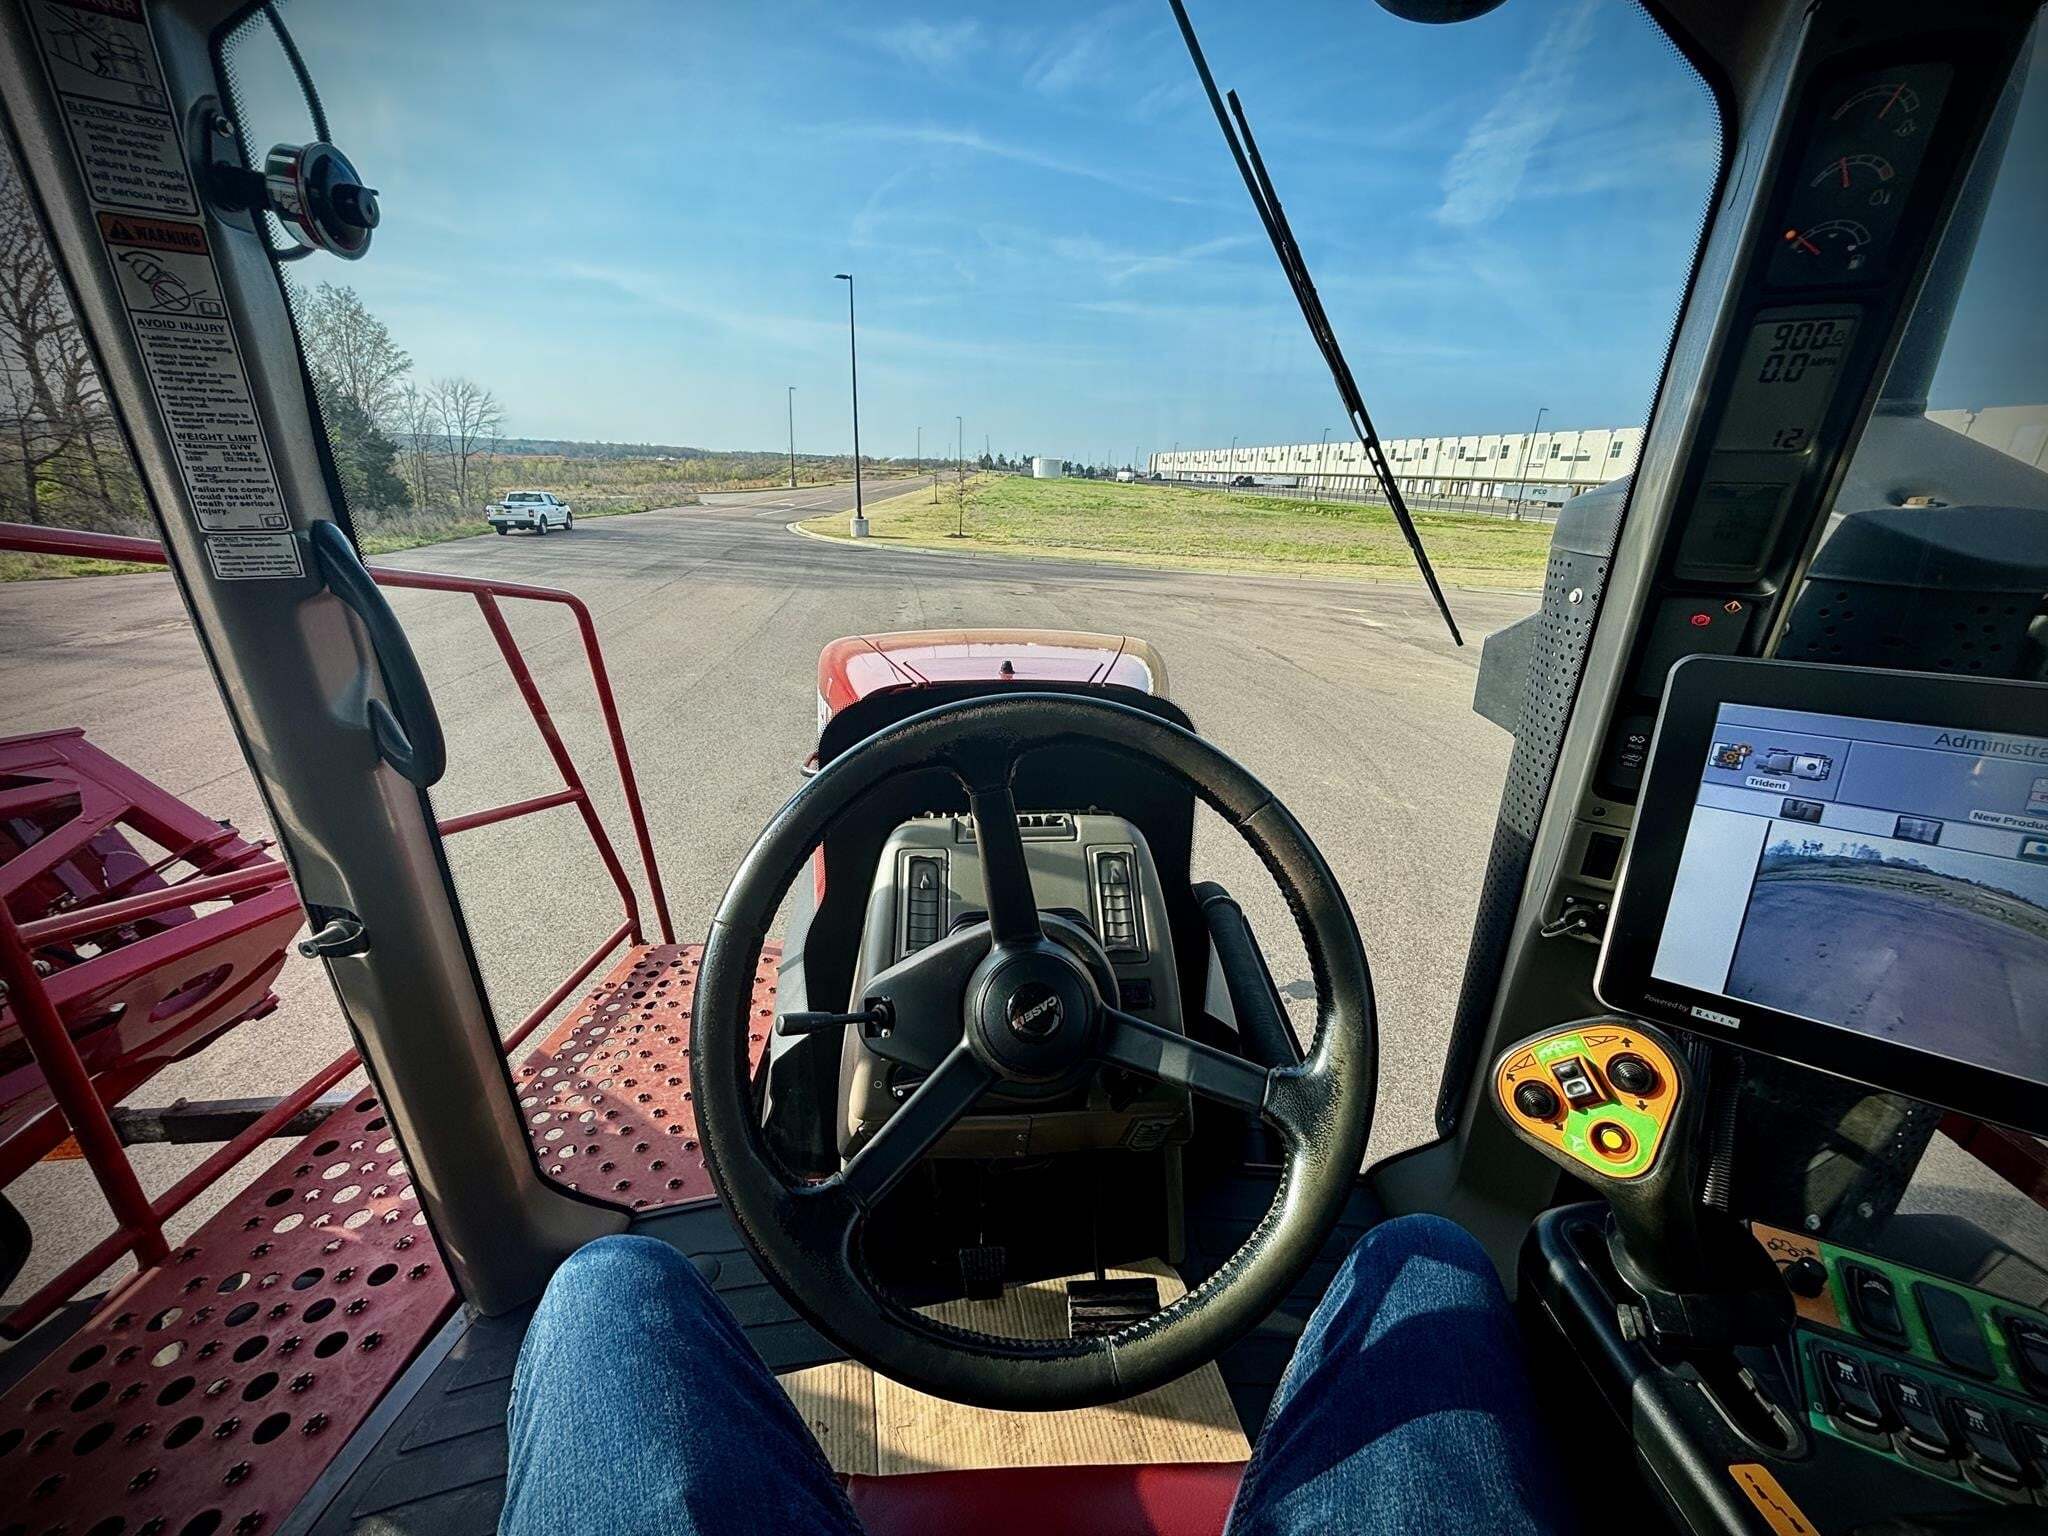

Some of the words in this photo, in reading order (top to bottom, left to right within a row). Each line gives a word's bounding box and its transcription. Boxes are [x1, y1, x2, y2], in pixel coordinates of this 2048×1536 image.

[137, 318, 176, 329] AVOID
[180, 321, 225, 333] INJURY
[1769, 322, 1835, 352] 900
[1758, 353, 1810, 383] 0.0
[174, 432, 223, 442] WEIGHT
[227, 434, 258, 442] LIMIT
[1774, 428, 1804, 448] 12
[241, 486, 275, 494] comply
[1750, 778, 1787, 790] Trident
[1973, 812, 2001, 823] New
[1024, 996, 1057, 1022] CASE
[1644, 993, 1678, 1009] Powered
[1678, 1004, 1690, 1012] by
[1695, 1008, 1736, 1025] RAVEN
